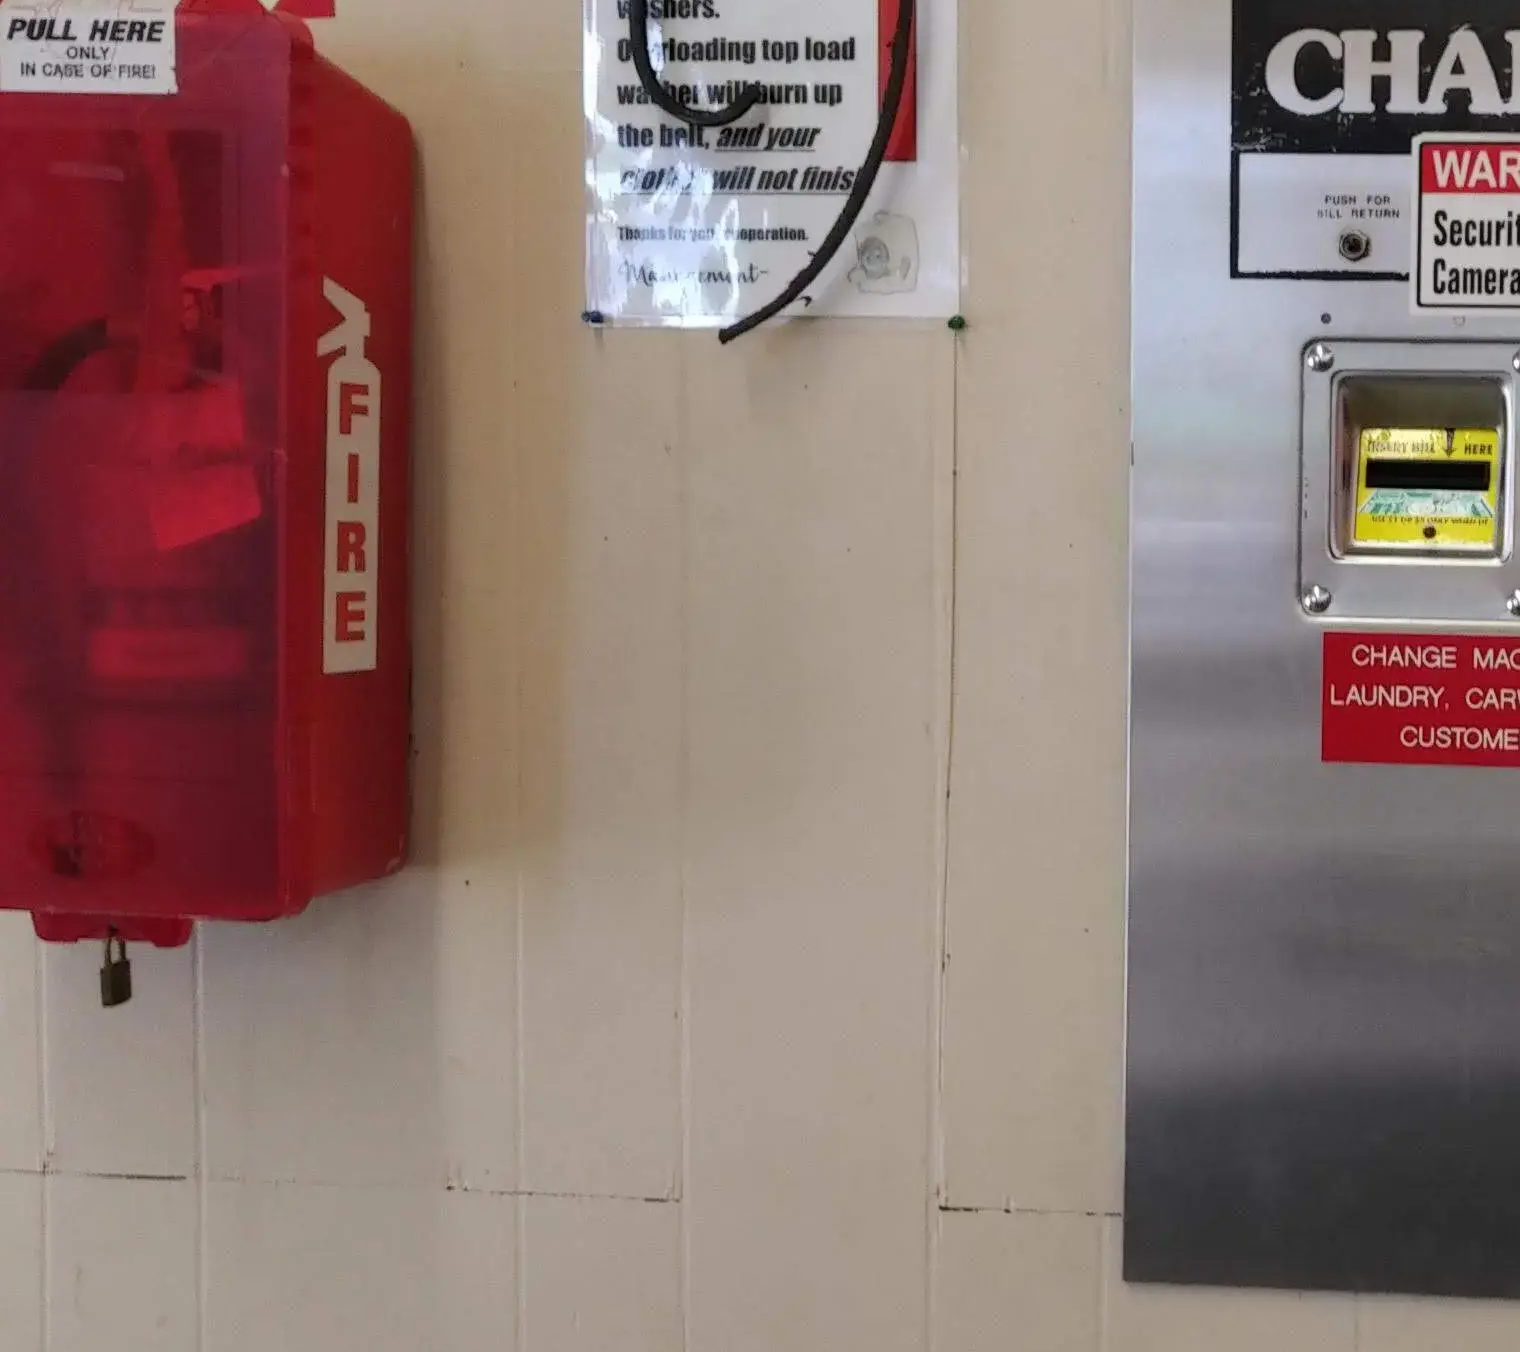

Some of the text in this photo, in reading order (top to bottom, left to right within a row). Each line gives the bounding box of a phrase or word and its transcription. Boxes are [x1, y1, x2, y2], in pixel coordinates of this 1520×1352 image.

[7, 17, 165, 43] PULL HERE
[66, 46, 110, 60] ONLY
[617, 36, 856, 64] Orloading top load
[20, 61, 36, 77] IN
[90, 63, 112, 78] OF
[617, 80, 699, 105] waher
[814, 83, 843, 106] up
[617, 123, 654, 148] the
[716, 123, 765, 148] and
[765, 126, 821, 151] your
[713, 166, 757, 190] will
[757, 167, 801, 190] not
[801, 167, 862, 191] finis
[1366, 194, 1391, 205] FOR
[1464, 443, 1493, 456] HERE
[335, 381, 369, 643] FIRE
[1351, 644, 1457, 669] CHANGE
